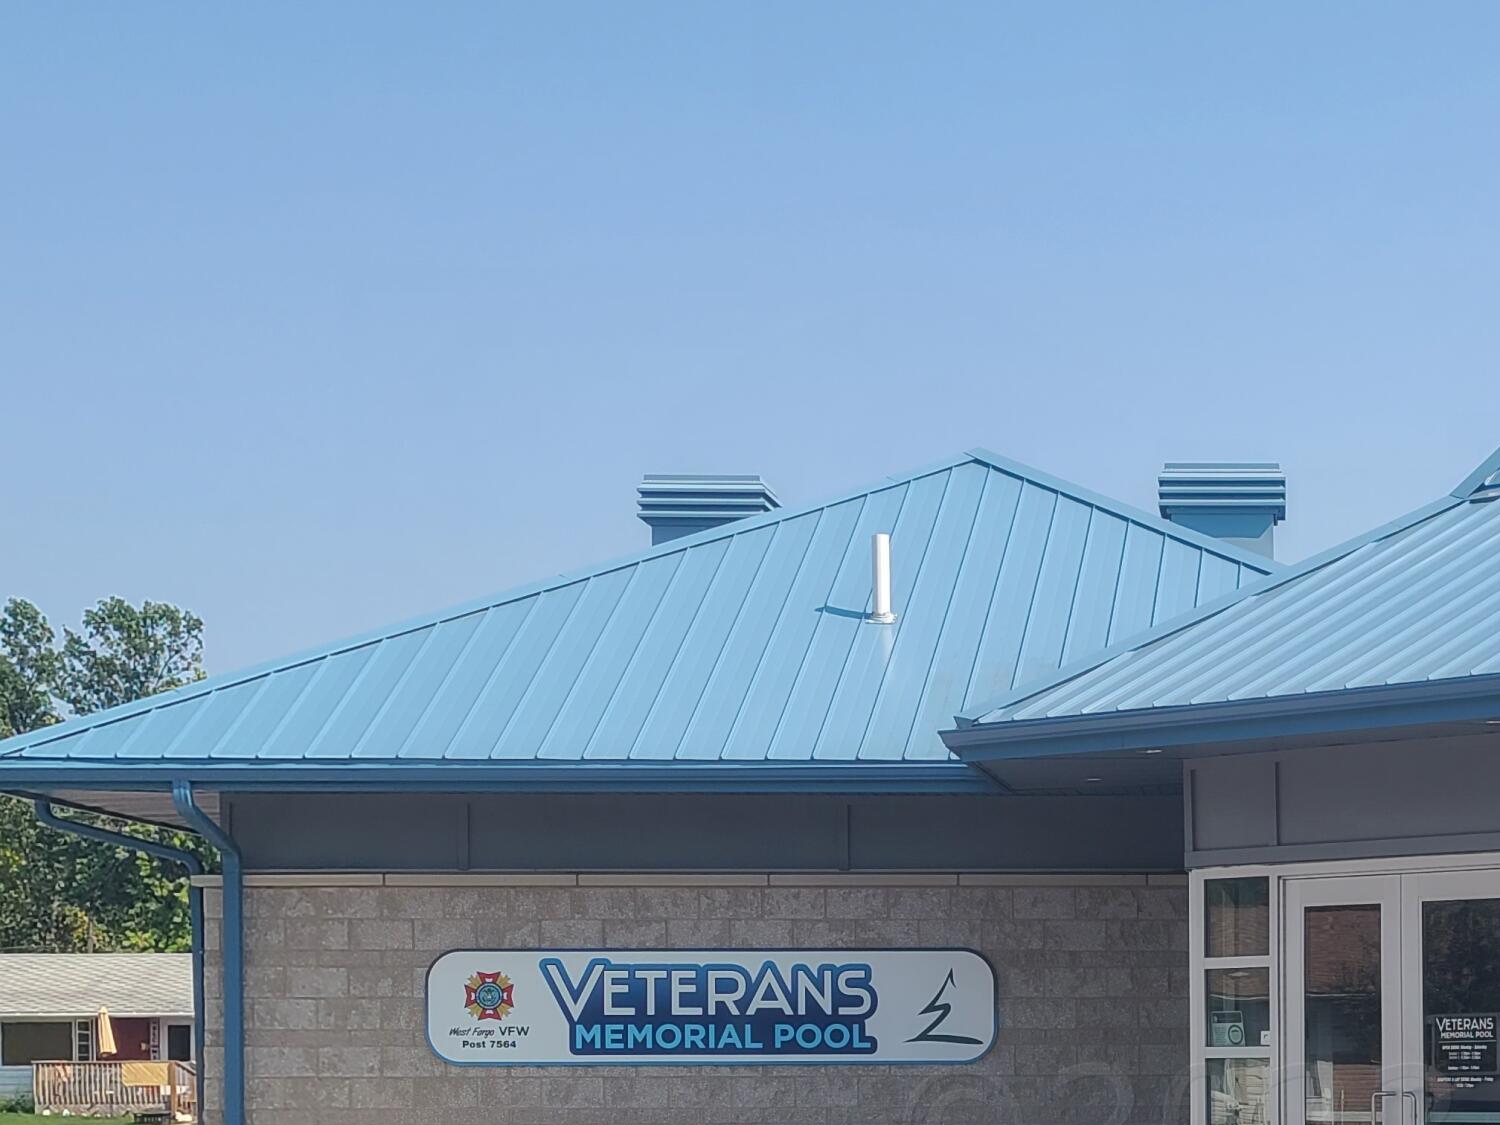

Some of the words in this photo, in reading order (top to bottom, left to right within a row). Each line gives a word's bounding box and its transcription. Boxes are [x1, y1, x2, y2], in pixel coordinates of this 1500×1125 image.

[546, 963, 871, 1023] VETERANS
[1435, 1017, 1494, 1032] VETERANS
[449, 1026, 471, 1036] West
[472, 1026, 495, 1039] Fargo
[499, 1026, 530, 1036] VFW
[575, 1023, 767, 1050] MEMORIAL
[775, 1023, 871, 1049] POOL
[1441, 1031, 1473, 1039] MEMORIAL
[1475, 1030, 1494, 1038] POOL
[462, 1040, 486, 1049] Post
[490, 1040, 517, 1048] 7564
